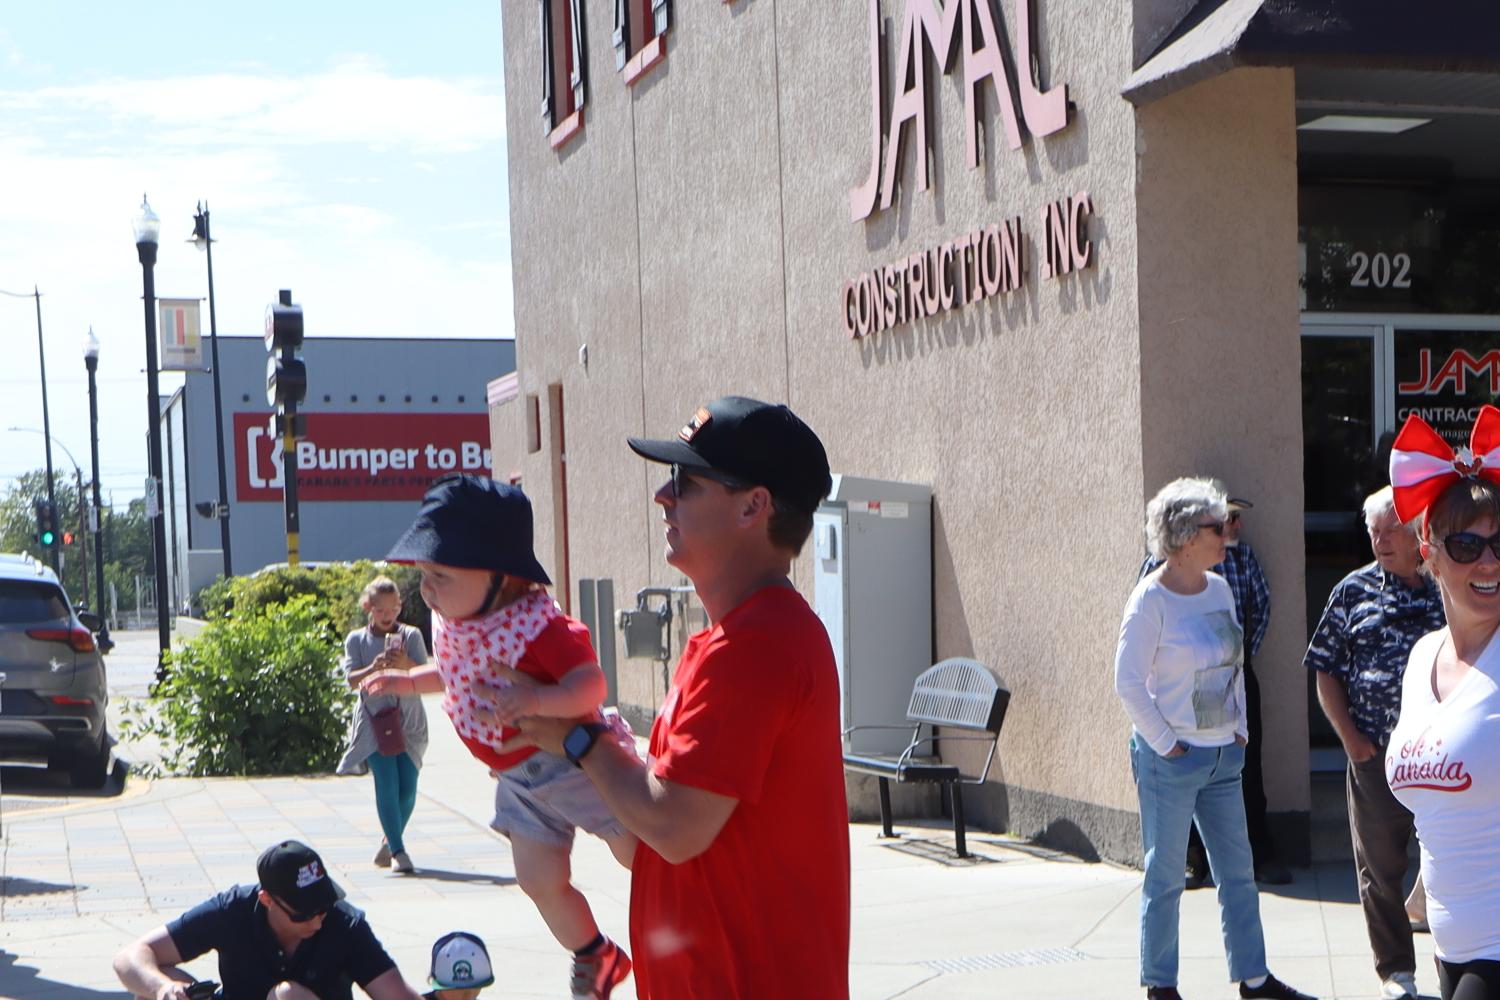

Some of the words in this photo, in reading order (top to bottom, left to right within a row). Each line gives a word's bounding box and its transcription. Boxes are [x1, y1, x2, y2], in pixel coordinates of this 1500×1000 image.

[843, 216, 1022, 339] CONSTRUCTION
[1041, 190, 1095, 281] INC
[1350, 251, 1412, 288] 202
[296, 441, 419, 476] Bumper
[425, 444, 457, 470] to
[1386, 753, 1465, 786] Canada
